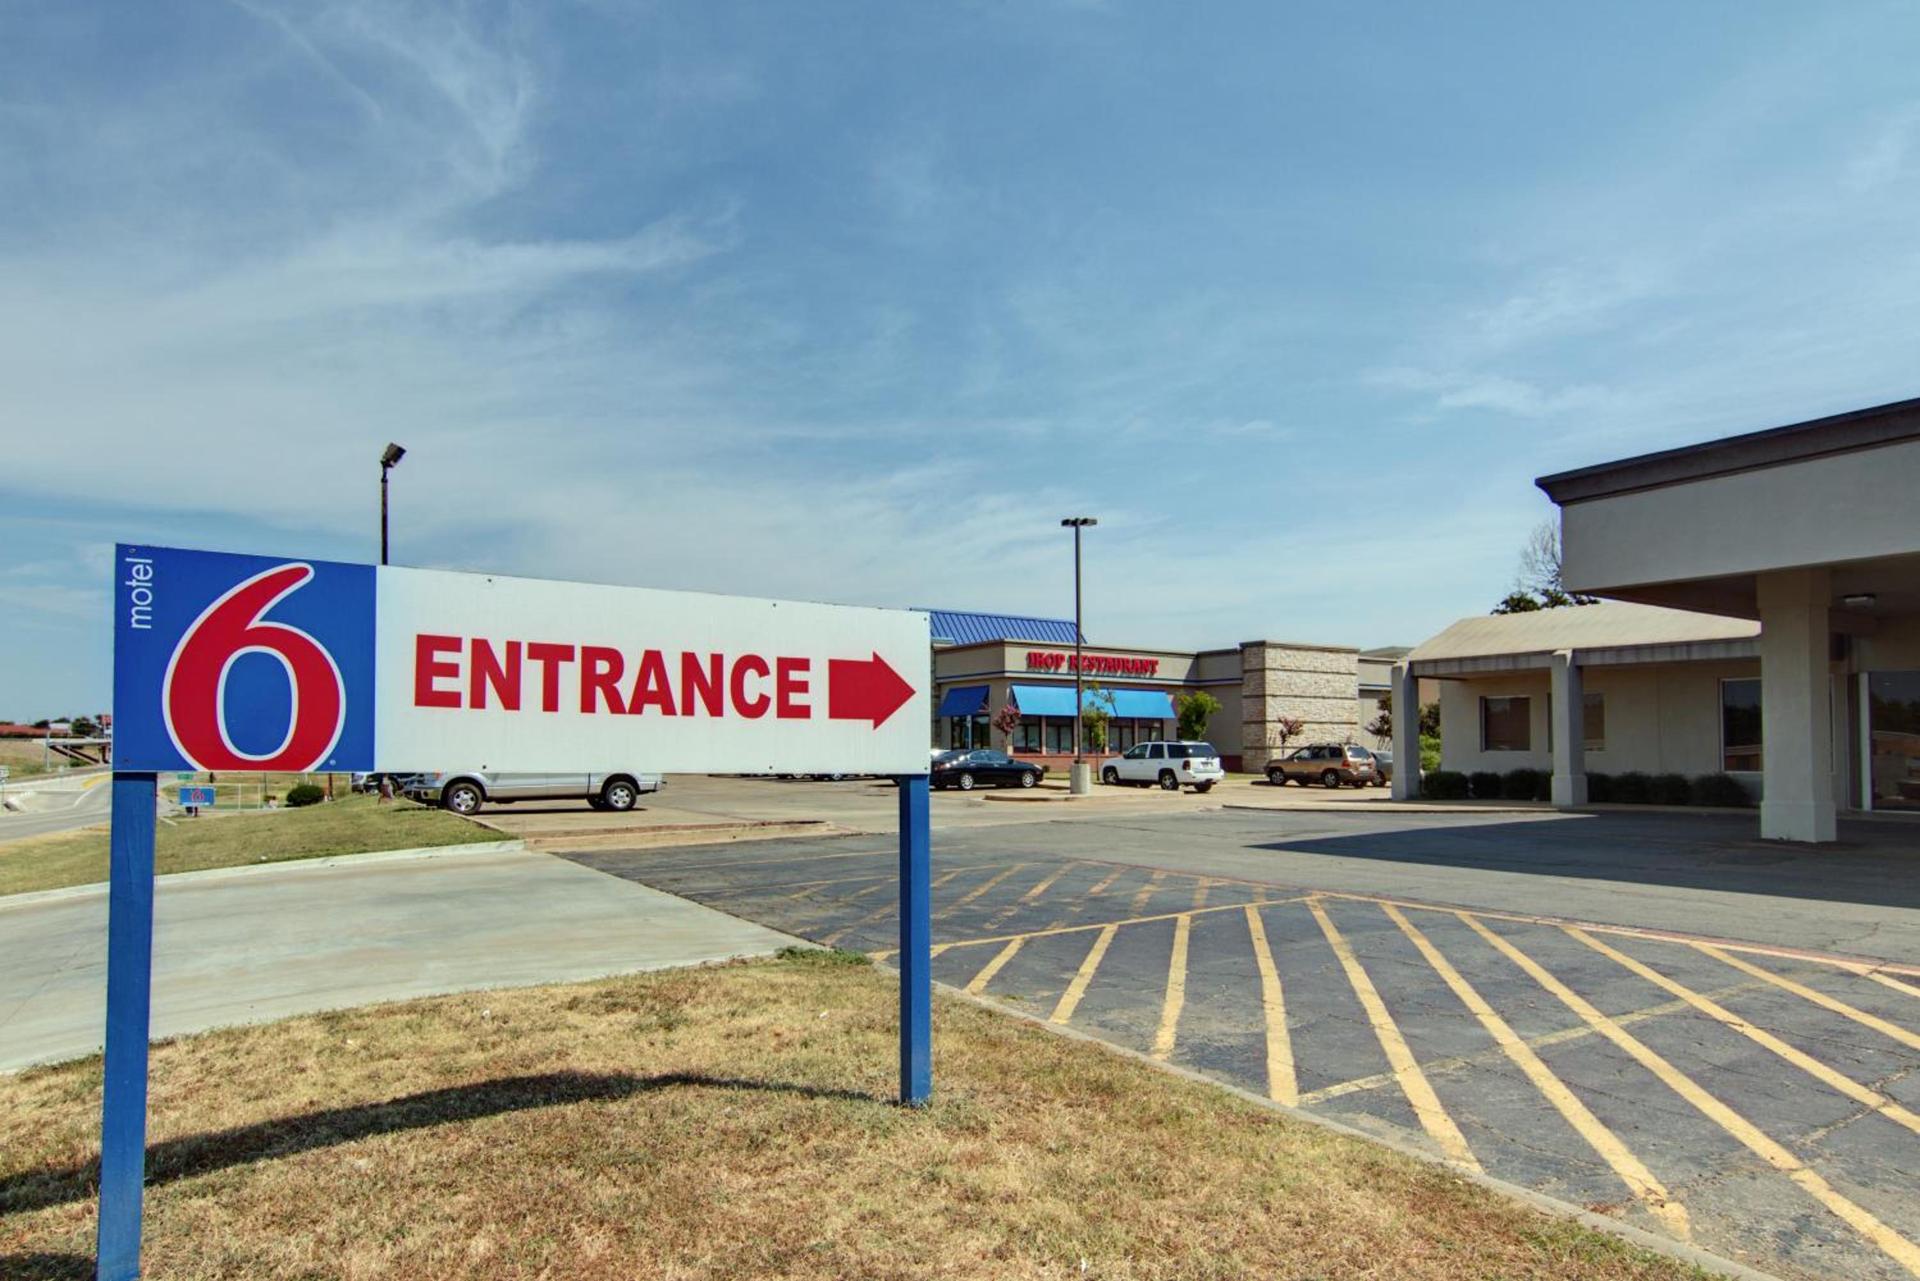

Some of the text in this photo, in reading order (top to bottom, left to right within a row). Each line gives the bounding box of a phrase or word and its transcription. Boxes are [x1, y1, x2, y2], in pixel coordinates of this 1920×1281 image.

[125, 557, 153, 629] motel
[162, 562, 346, 771] 6
[414, 633, 812, 719] ENTRANCE
[1027, 652, 1159, 674] IHOP RESTAURANT
